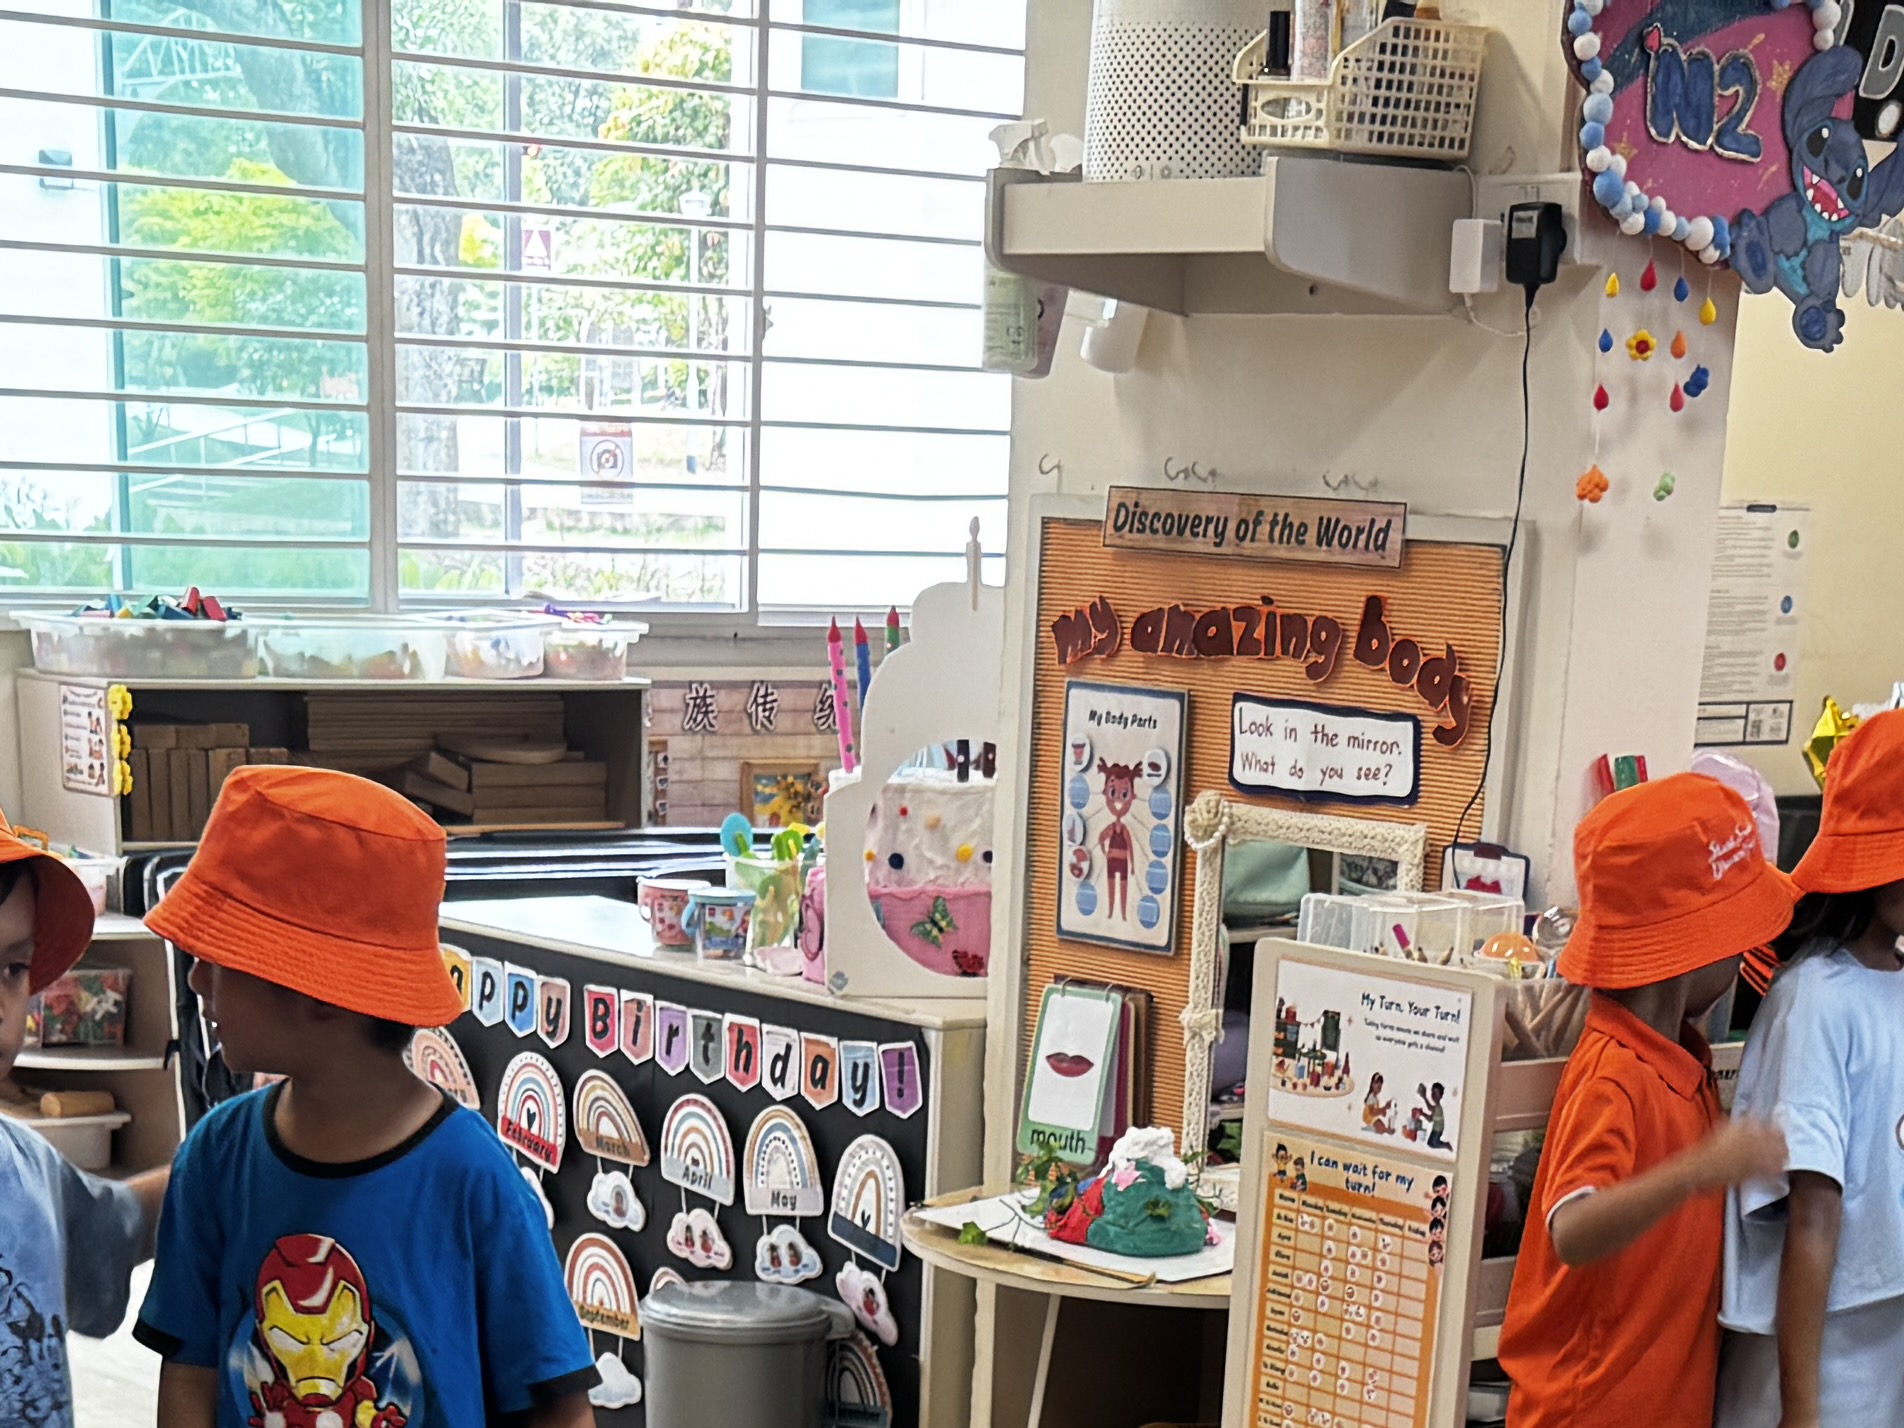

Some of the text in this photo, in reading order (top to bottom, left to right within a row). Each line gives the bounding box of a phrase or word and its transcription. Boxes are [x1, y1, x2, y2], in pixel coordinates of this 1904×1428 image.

[1112, 501, 1394, 553] Discovery of the World
[1130, 594, 1343, 684] amazing
[1353, 594, 1474, 750] body
[1130, 712, 1158, 731] Parts
[1238, 706, 1404, 756] Look in the mirror.
[1240, 752, 1393, 787] What do you see?
[1361, 992, 1375, 1011] My
[1407, 1001, 1430, 1018] Your
[1433, 1004, 1461, 1024] Turn!
[591, 997, 907, 1111] Birthday!
[596, 1137, 630, 1157] March
[1029, 1128, 1087, 1155] mouth
[681, 1165, 714, 1191] April
[1310, 1150, 1415, 1194] I can wait for my
[1345, 1176, 1376, 1199] turn!
[769, 1190, 798, 1212] May
